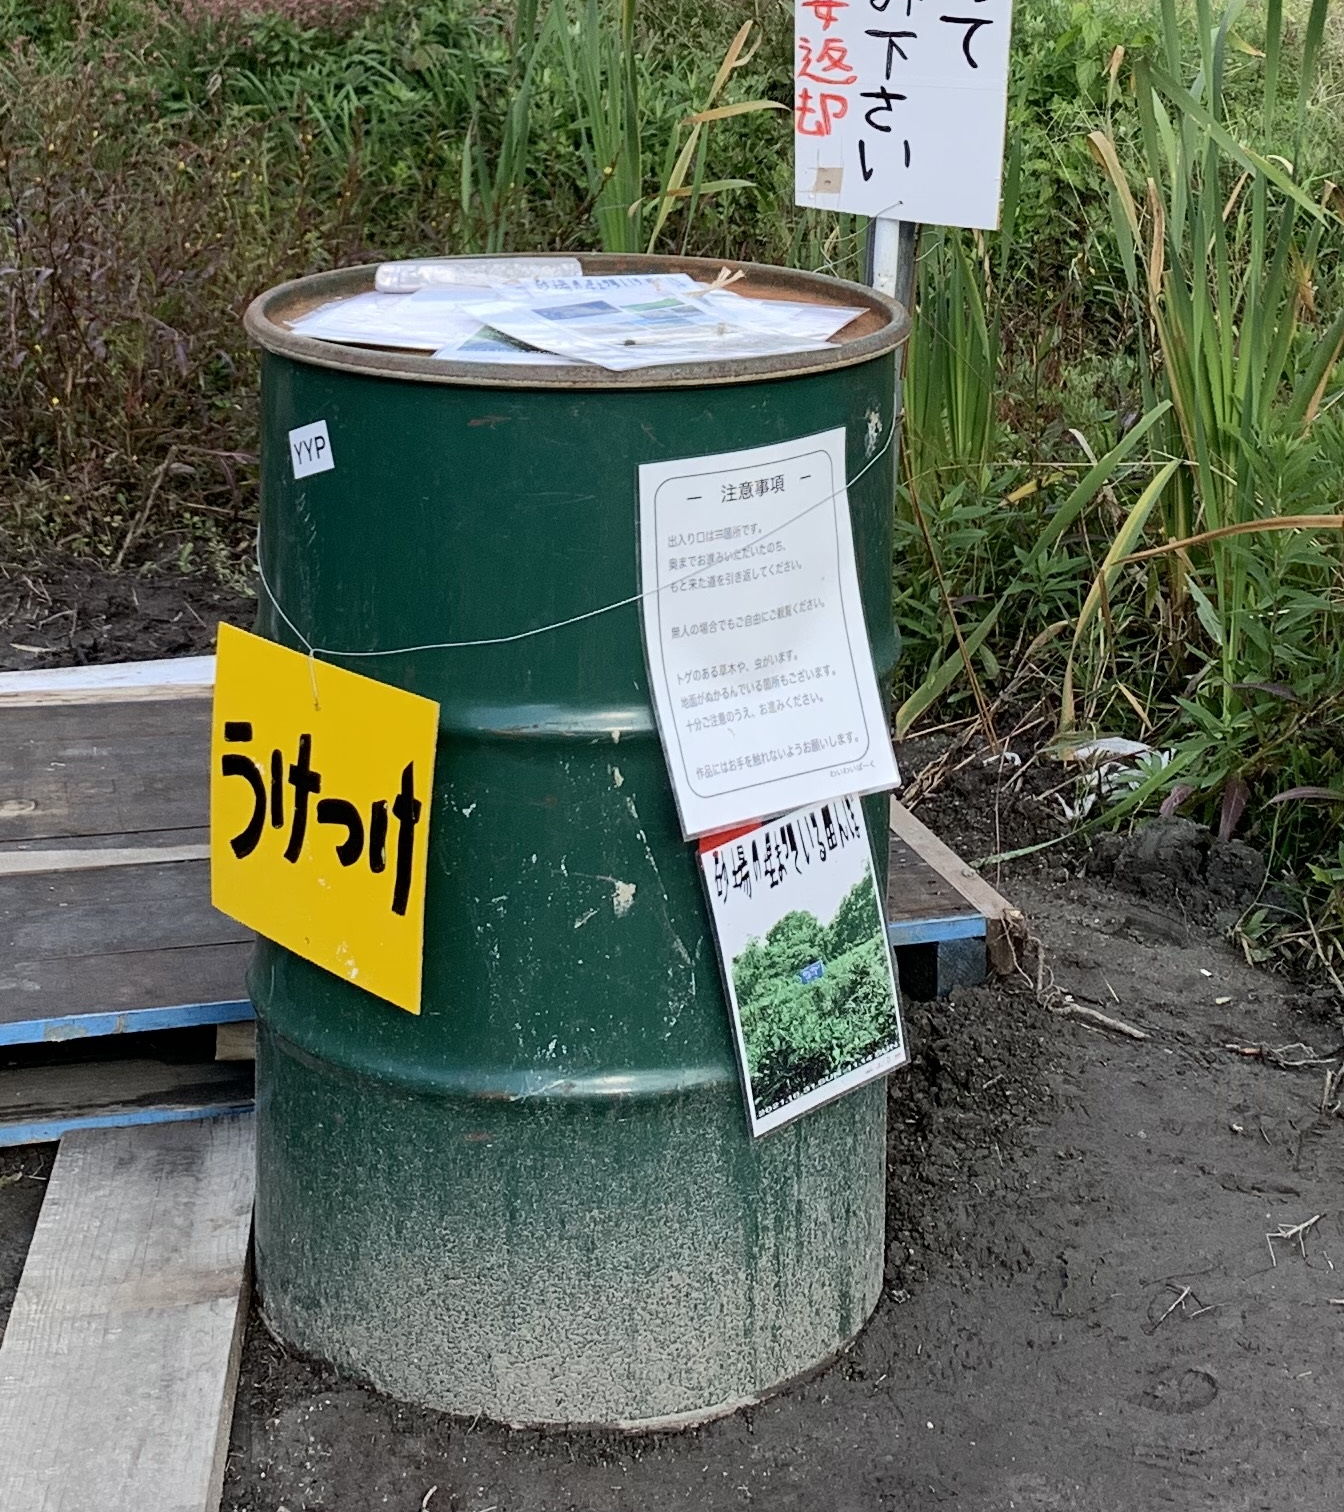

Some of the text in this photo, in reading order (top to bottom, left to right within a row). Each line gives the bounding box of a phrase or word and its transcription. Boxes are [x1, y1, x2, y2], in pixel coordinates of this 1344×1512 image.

[293, 435, 326, 465] YYP
[222, 721, 422, 916] うけつけ
